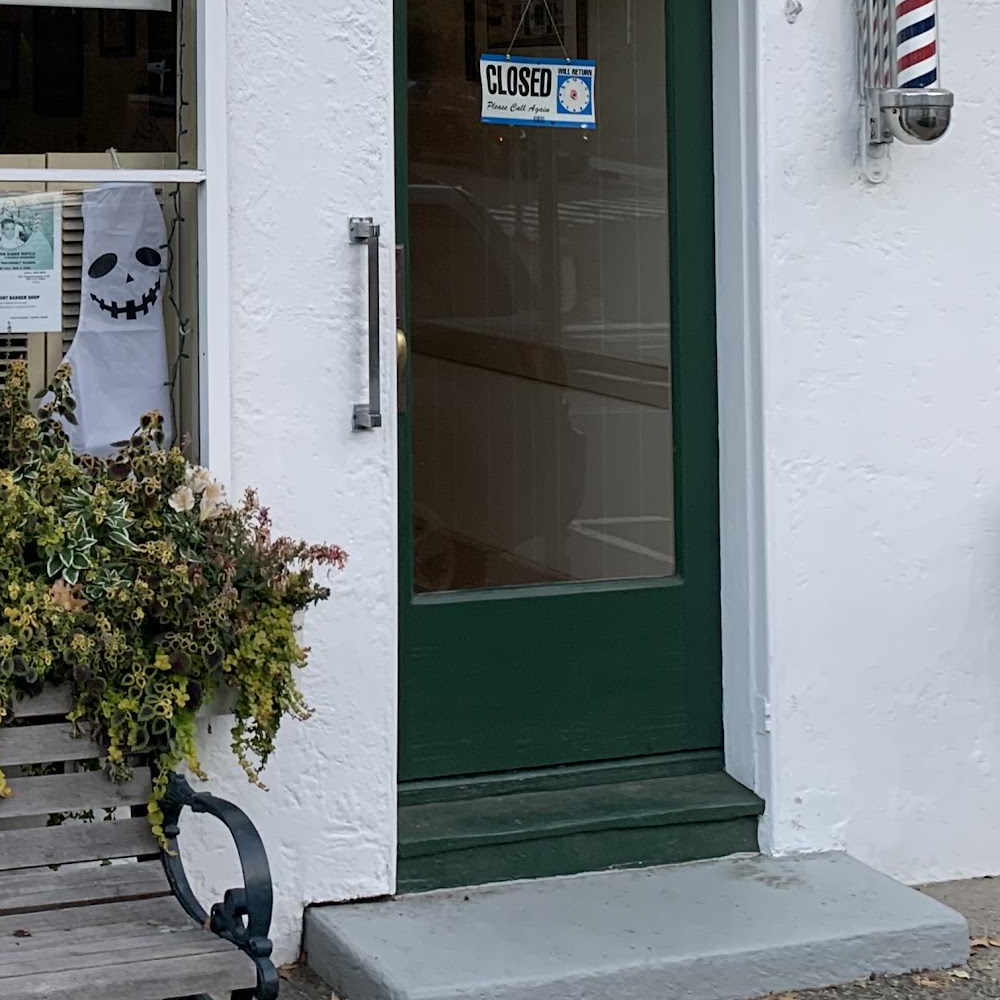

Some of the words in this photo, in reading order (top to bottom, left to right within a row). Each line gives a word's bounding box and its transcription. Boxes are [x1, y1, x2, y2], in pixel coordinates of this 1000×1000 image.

[571, 68, 592, 76] RETURN
[486, 64, 552, 97] CLOSED
[487, 101, 508, 110] Please
[510, 103, 526, 112] Call
[528, 104, 550, 114] Again
